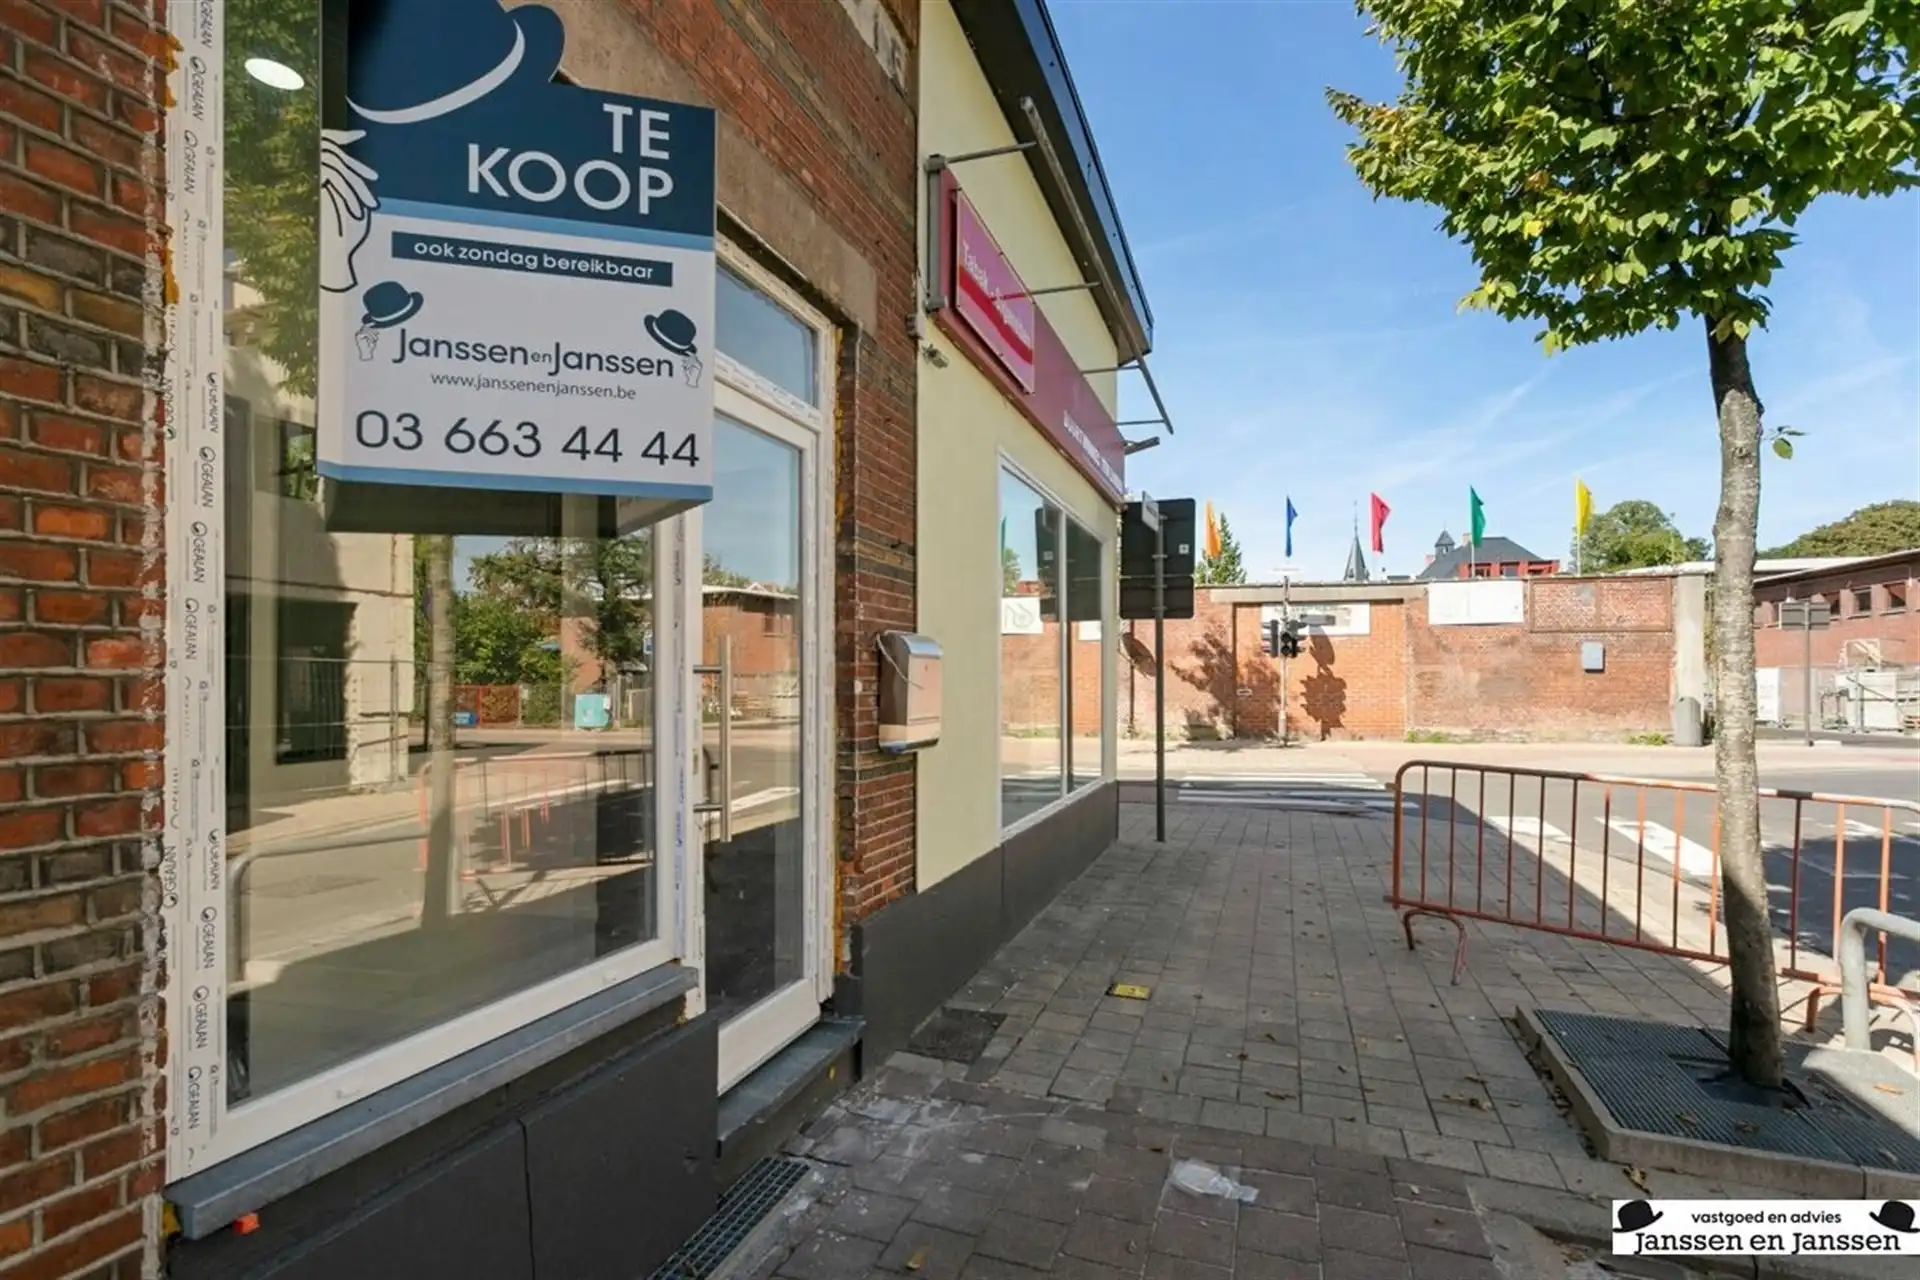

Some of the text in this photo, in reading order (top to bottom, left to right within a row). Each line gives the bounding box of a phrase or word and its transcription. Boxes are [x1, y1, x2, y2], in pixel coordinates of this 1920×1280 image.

[603, 102, 670, 160] TE
[468, 143, 674, 215] KOOP
[414, 240, 653, 280] ook zondag bereikbaar
[392, 328, 674, 378] Janssen en Janssen
[430, 372, 637, 401] www.janssenenjanssen.be
[356, 410, 700, 467] 03 663 44 44
[201, 462, 214, 508] GEALAN
[193, 538, 206, 583] GEALAN
[185, 613, 197, 660] GEALAN
[202, 922, 215, 969] GEALAN
[195, 1002, 208, 1049] GEALAN
[188, 1081, 200, 1130] GEALAN
